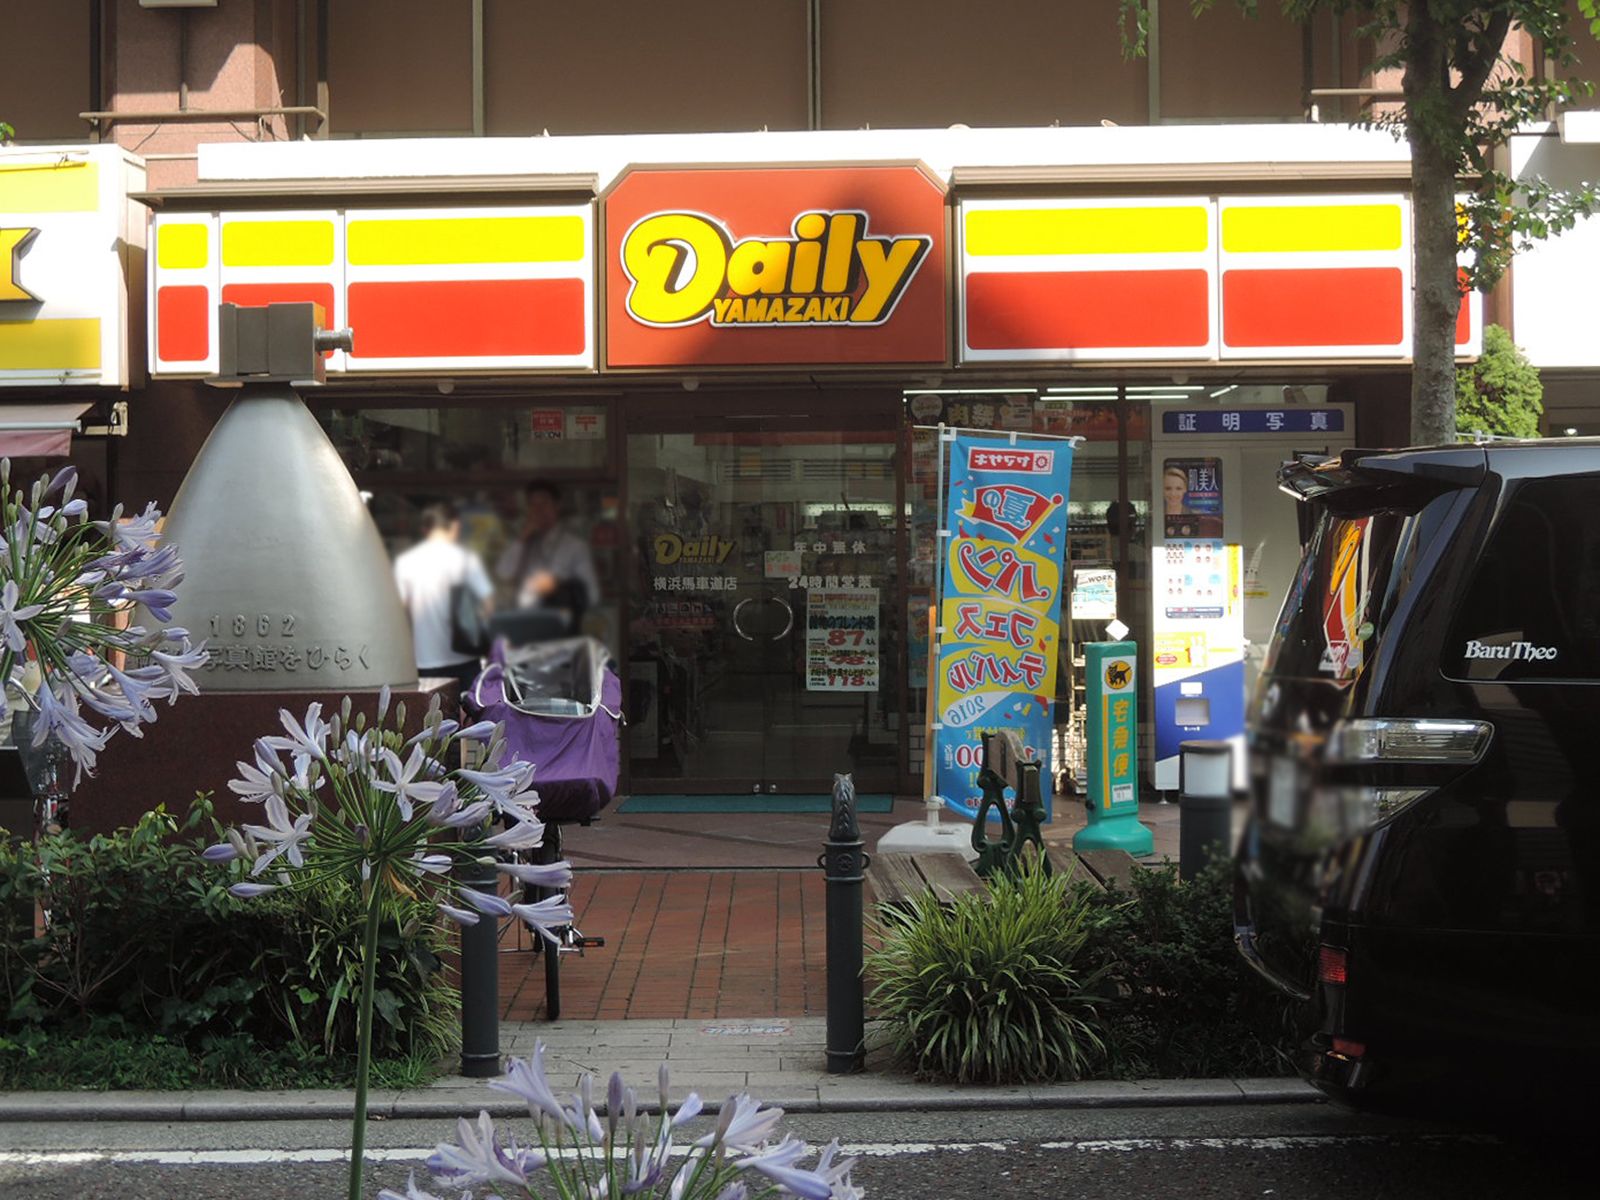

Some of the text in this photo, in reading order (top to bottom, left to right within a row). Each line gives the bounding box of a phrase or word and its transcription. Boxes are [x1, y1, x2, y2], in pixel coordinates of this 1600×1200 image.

[623, 212, 931, 325] Daily
[713, 297, 850, 323] YAMAZAKI
[1178, 412, 1328, 431] 証明写真
[1188, 467, 1219, 492] 肌美人
[654, 533, 735, 565] Daily
[793, 540, 866, 554] 年中無休
[653, 576, 737, 591] 横浜馬車道店
[788, 575, 872, 589] 24時間営業
[209, 614, 296, 638] 1862
[827, 629, 865, 646] 87
[1113, 699, 1130, 778] 宅急便
